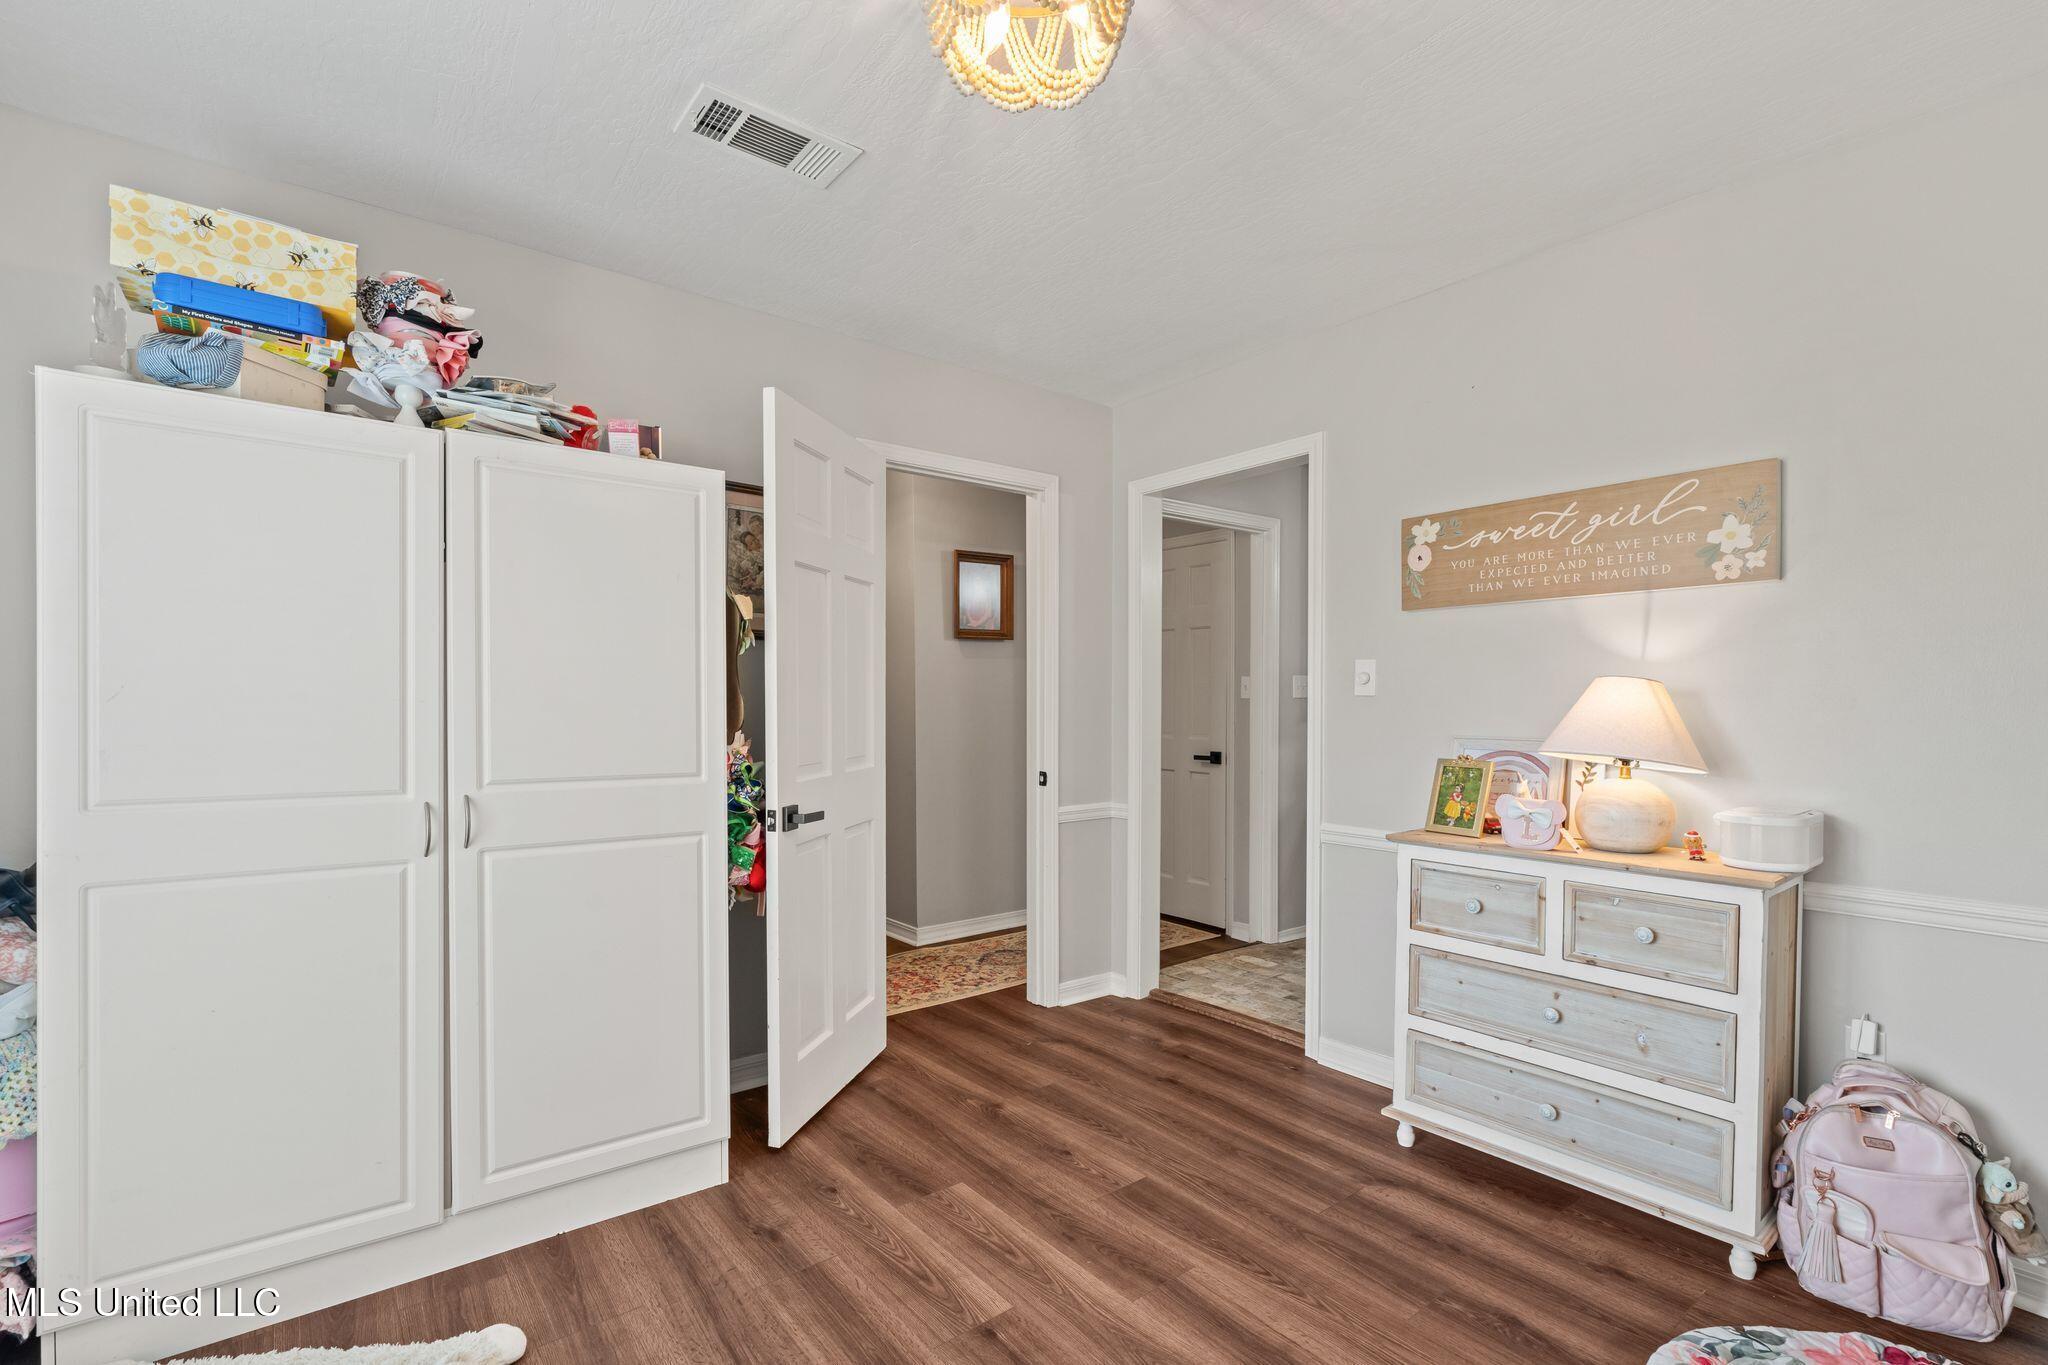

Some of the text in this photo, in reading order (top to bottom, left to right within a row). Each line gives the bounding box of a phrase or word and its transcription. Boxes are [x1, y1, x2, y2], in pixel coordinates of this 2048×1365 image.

[191, 311, 204, 319] First
[234, 320, 254, 329] Shapes
[1443, 478, 1707, 550] sweet girl
[1450, 531, 1697, 570] YOU ARE MORE THAN WE EVER
[1468, 564, 1671, 593] THAN WE EVER IMAGINED
[1480, 551, 1657, 580] EXPECTED AND BETTER
